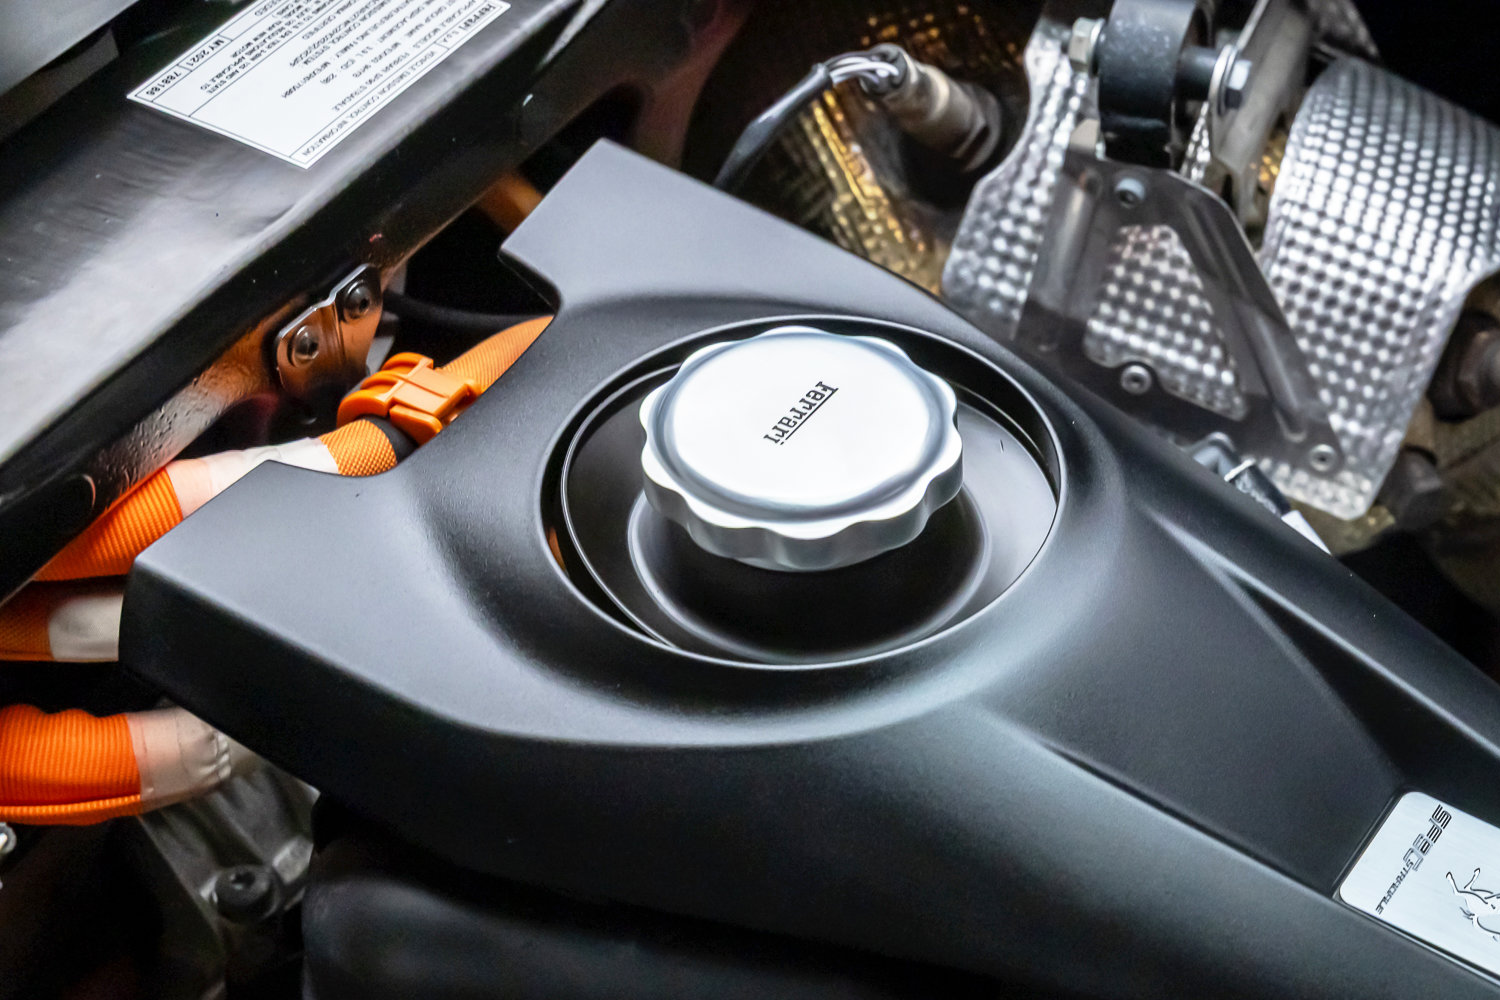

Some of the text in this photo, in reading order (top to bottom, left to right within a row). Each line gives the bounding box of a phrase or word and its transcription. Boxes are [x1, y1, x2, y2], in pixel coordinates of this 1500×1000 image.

[300, 14, 336, 40] CERTIFIED
[373, 5, 425, 42] DISPLACEMENT
[458, 4, 496, 30] Ferrari
[244, 26, 286, 56] REGULATIONS
[329, 21, 362, 44] CONTROL
[411, 27, 441, 48] MODELS
[186, 39, 225, 67] MY 2021
[229, 41, 254, 58] MOTOR
[301, 44, 331, 65] SYSTEM
[380, 51, 410, 73] FERRARI
[408, 50, 437, 71] VEHICLE
[208, 56, 246, 82] APPLICABLE
[224, 69, 240, 80] AND
[206, 79, 227, 94] STATE
[377, 71, 411, 95] EMISSION
[331, 85, 368, 112] STRADALE
[347, 94, 381, 119] CONTROL
[300, 119, 349, 156] INFORMATION
[763, 381, 839, 446] Ferrari
[1375, 804, 1452, 915] SF90 STRADALE
